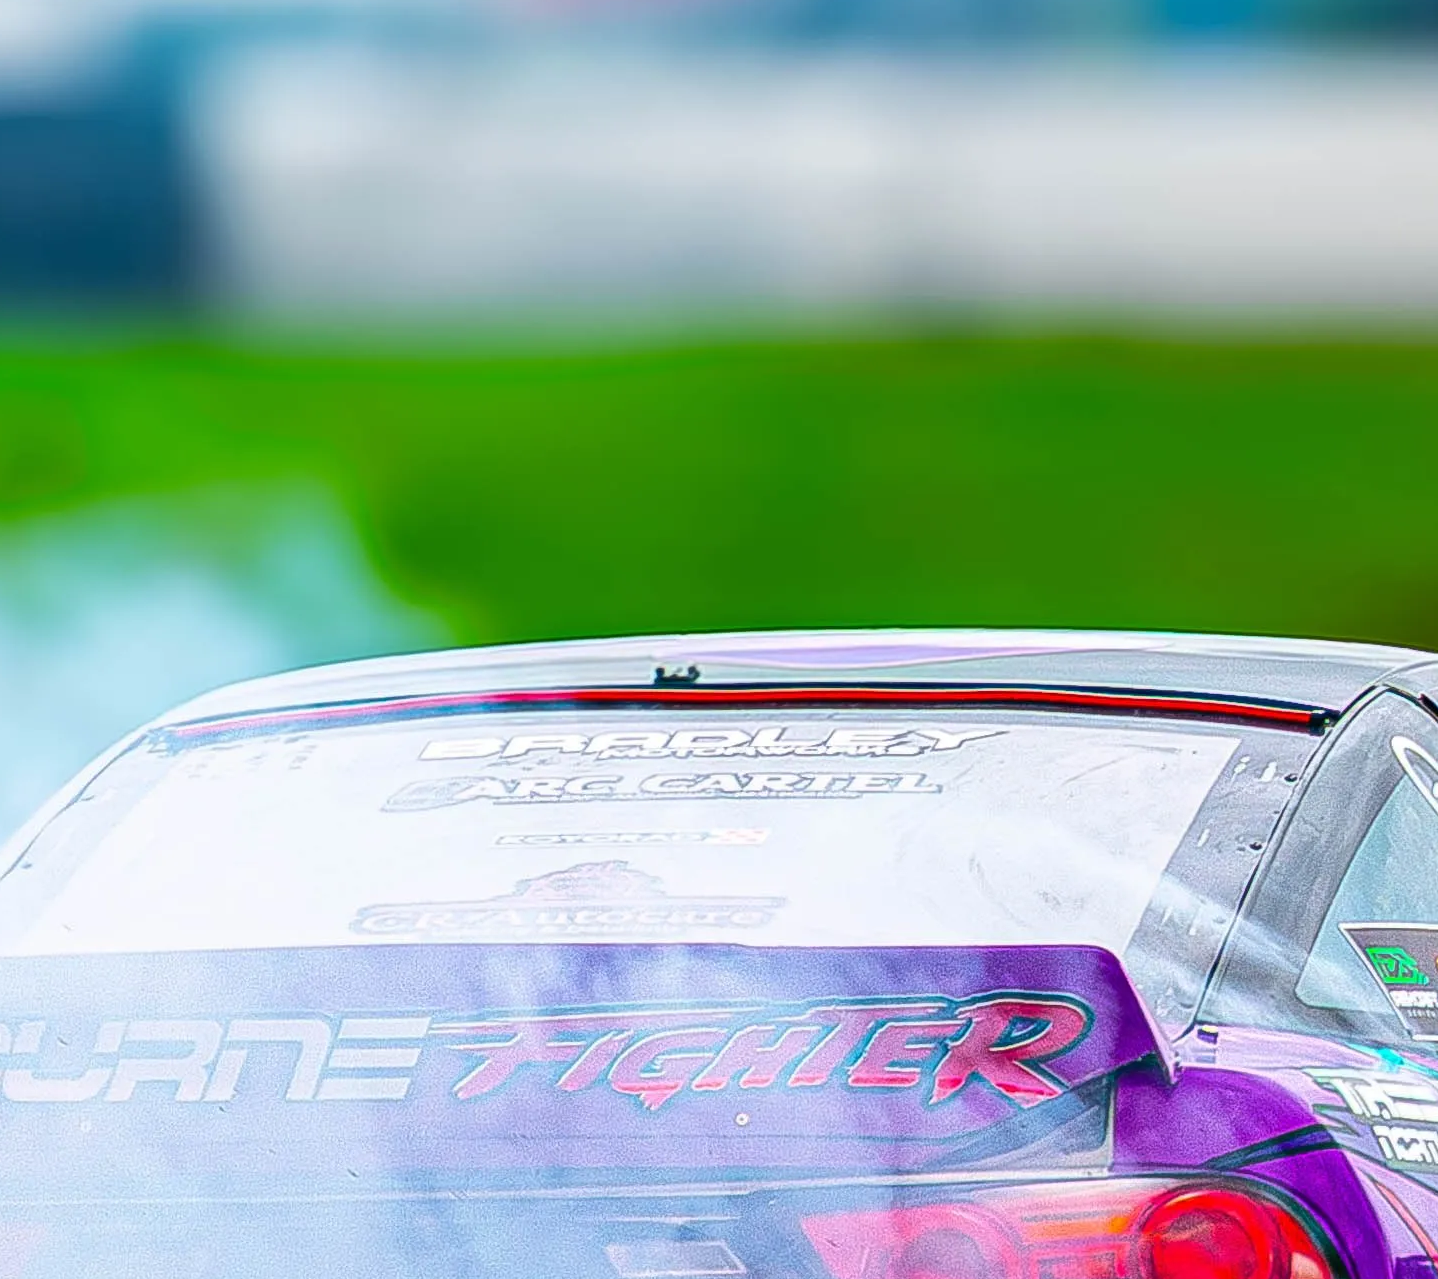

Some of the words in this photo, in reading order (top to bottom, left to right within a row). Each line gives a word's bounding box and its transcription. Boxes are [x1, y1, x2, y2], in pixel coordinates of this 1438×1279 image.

[419, 726, 1011, 761] BRADLEY
[459, 774, 624, 800] ARC
[641, 771, 942, 794] CARTEL
[430, 991, 1094, 1109] FIGHTER
